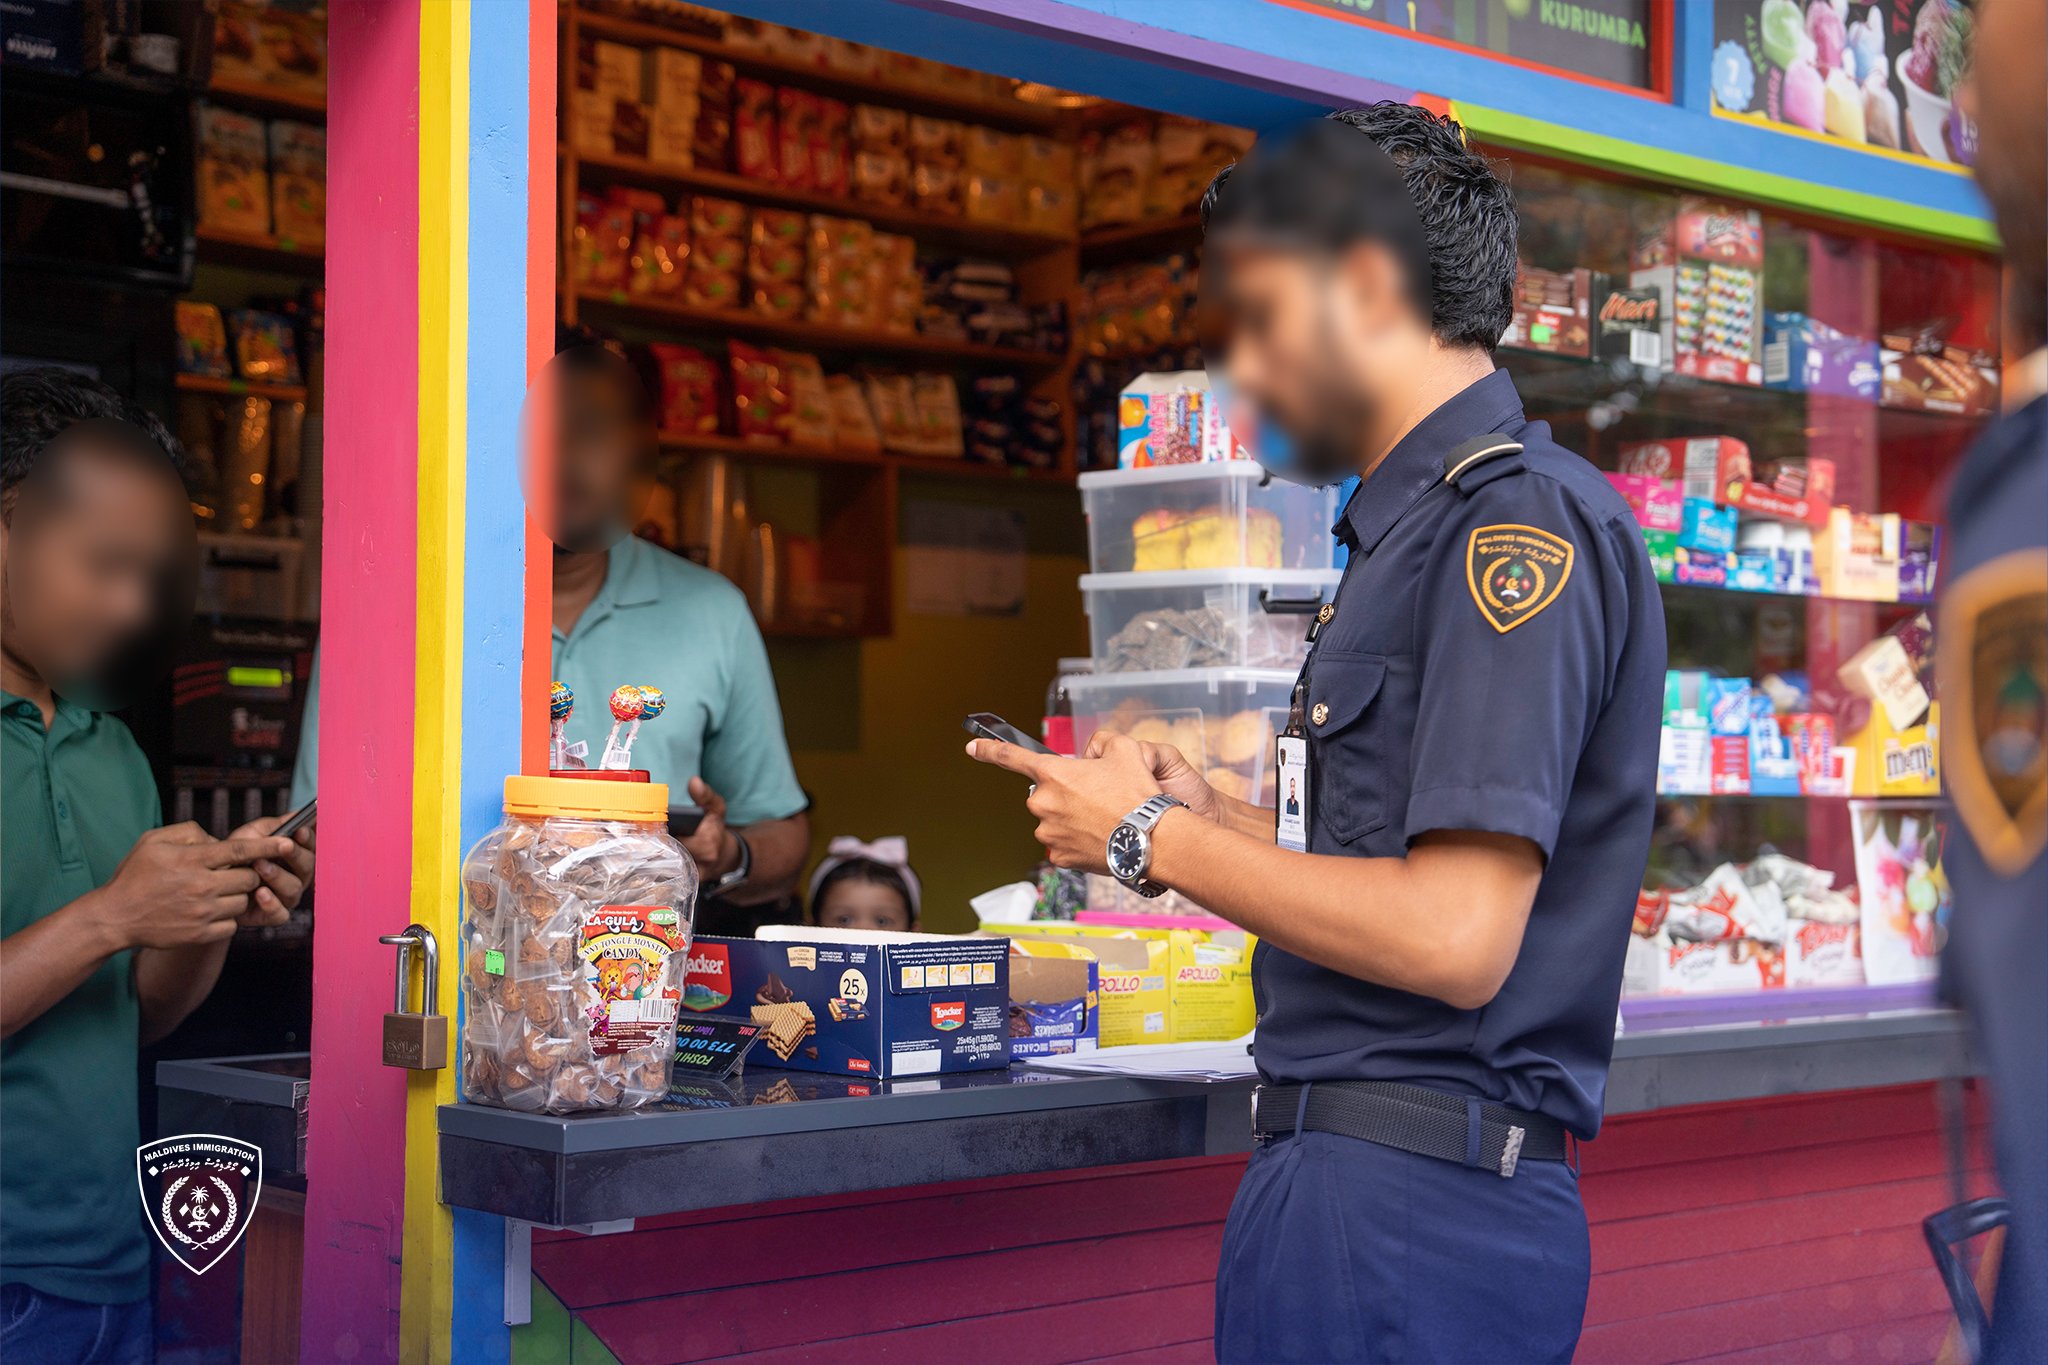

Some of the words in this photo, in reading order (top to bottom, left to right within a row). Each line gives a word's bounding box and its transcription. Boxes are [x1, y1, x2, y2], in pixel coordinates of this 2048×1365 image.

[1540, 0, 1646, 49] KURUMBA
[1600, 291, 1659, 322] Mars
[1477, 534, 1516, 545] MALDIVES
[1516, 535, 1567, 559] IMMIGRATION
[649, 912, 665, 921] 300
[601, 936, 632, 949] TONGUE
[603, 948, 641, 959] CANDY
[686, 953, 724, 975] acker
[1177, 967, 1219, 981] APOLLO
[843, 978, 860, 996] 25
[1099, 976, 1140, 992] POLLO
[934, 1007, 963, 1019] Loacker
[689, 1037, 709, 1050] 00
[707, 1040, 736, 1053] 773
[1012, 1043, 1040, 1053] CAKES
[683, 1052, 714, 1066] FOSHI
